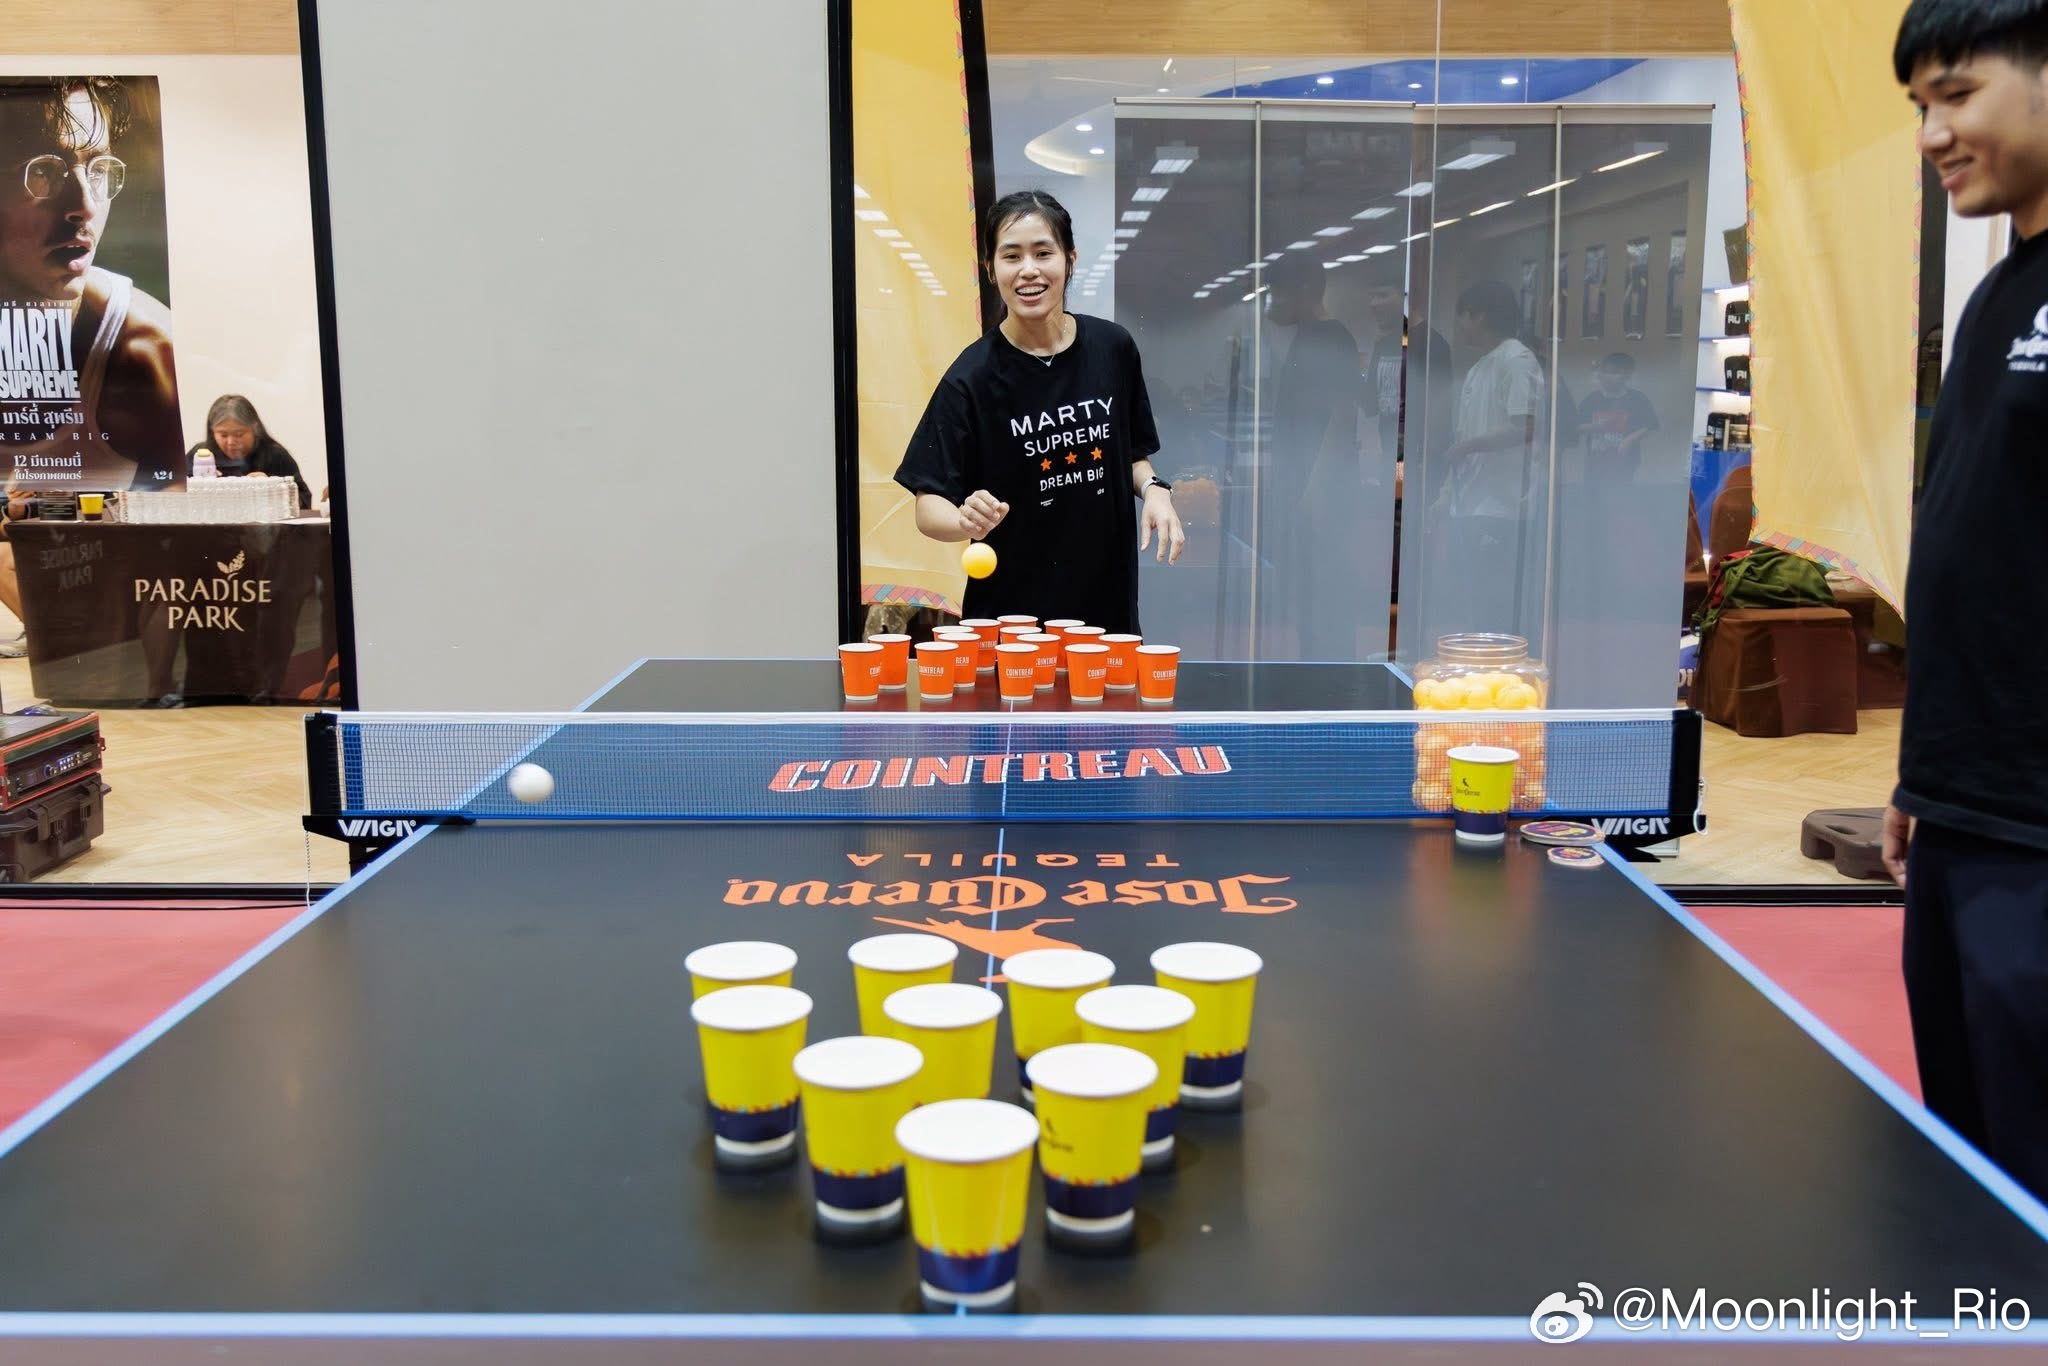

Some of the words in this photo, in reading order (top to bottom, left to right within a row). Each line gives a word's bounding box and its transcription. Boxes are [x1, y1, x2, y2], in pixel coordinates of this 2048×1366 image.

[0, 308, 73, 371] MARTY
[0, 370, 81, 399] SUPREME
[1010, 396, 1113, 437] MARTY
[72, 432, 110, 441] BIG
[1024, 423, 1110, 457] SUPREME
[13, 454, 28, 467] 12
[30, 451, 82, 467] มีนาคมนี้
[152, 470, 173, 481] A24
[1039, 471, 1083, 491] DREAM
[1086, 466, 1104, 482] BIG
[134, 577, 272, 603] PARADISE
[167, 605, 245, 632] PARK
[767, 745, 1233, 793] COINTREAU
[845, 852, 1180, 868] TEQUILA
[722, 875, 1048, 916] Cuervo
[1061, 874, 1298, 915] Jose
